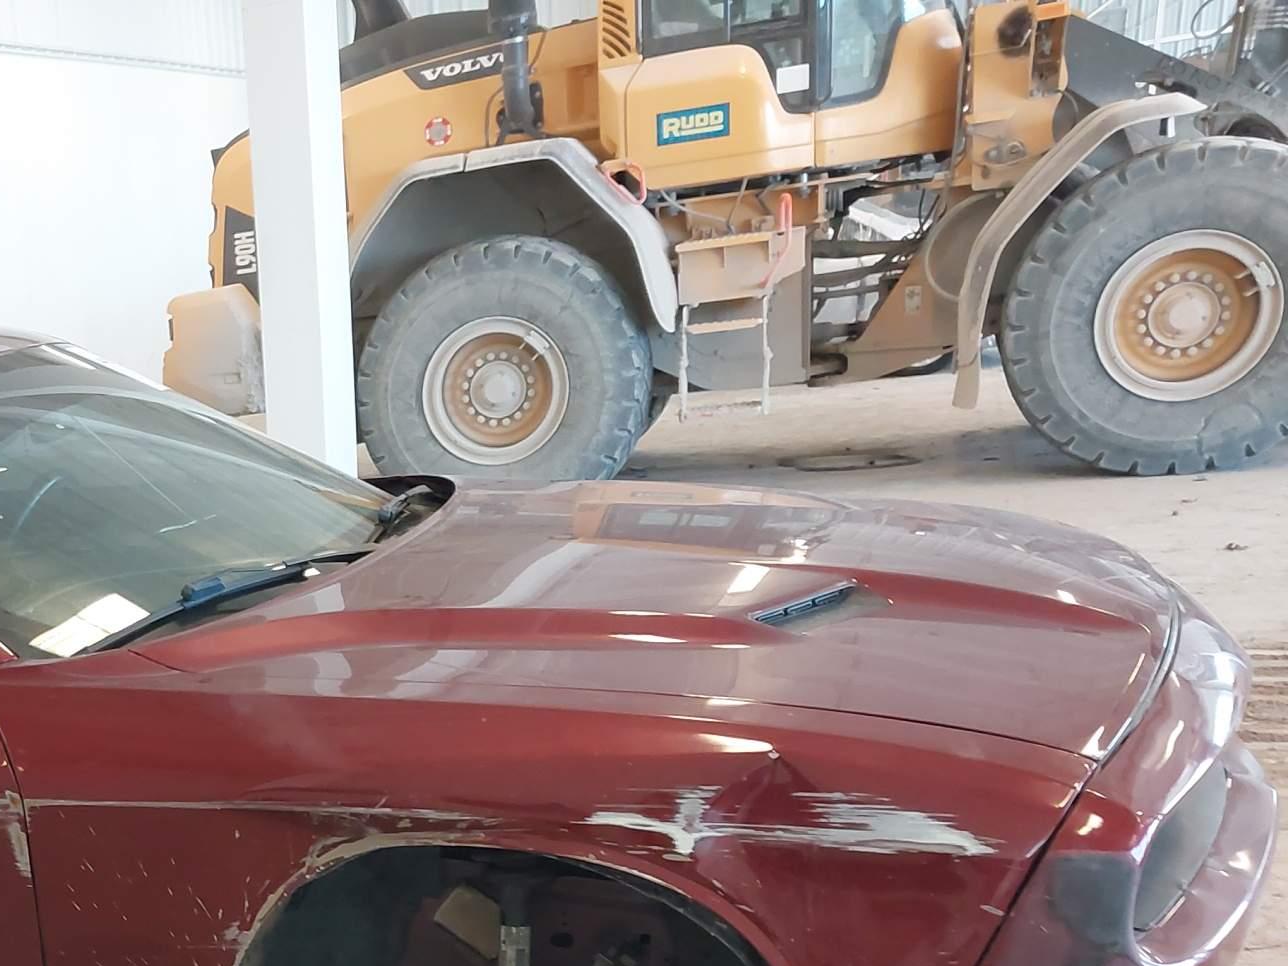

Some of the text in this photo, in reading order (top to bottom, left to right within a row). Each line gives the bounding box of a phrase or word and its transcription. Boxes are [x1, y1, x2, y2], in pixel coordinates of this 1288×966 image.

[420, 52, 504, 81] VOLV
[663, 110, 724, 139] RUDD
[234, 230, 257, 275] L90H
